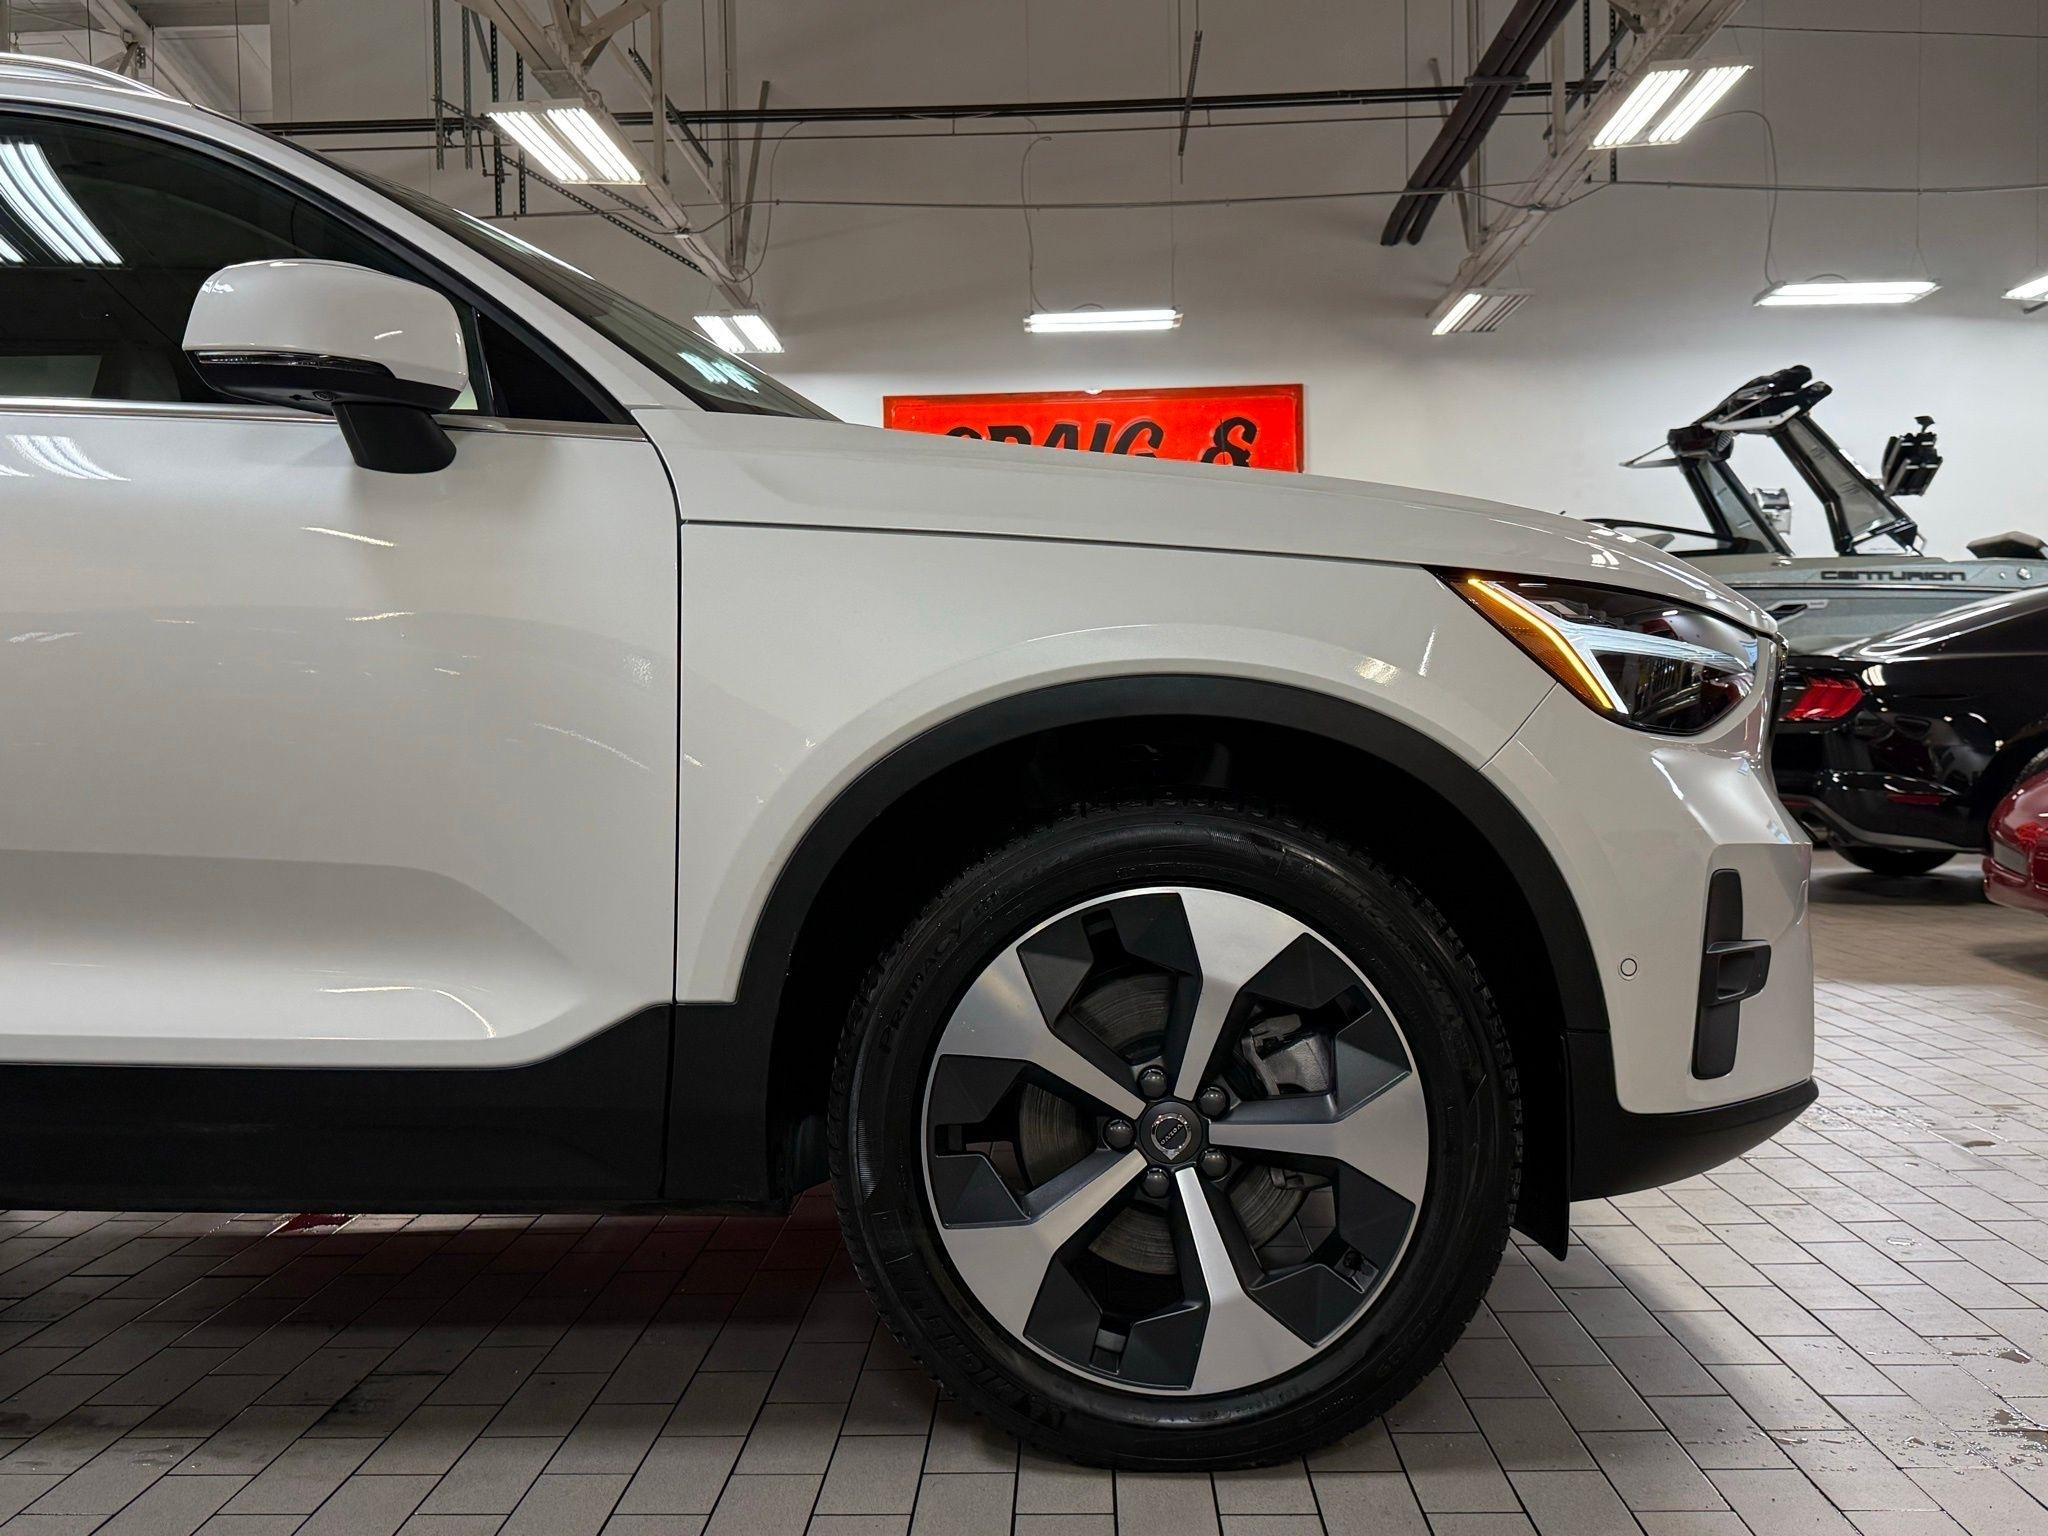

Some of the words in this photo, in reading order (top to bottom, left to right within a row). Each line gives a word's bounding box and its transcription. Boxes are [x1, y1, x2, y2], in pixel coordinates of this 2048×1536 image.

[945, 420, 1164, 459] AIG
[1820, 570, 1967, 582] CENTURION
[1160, 1123, 1183, 1145] VOLVO
